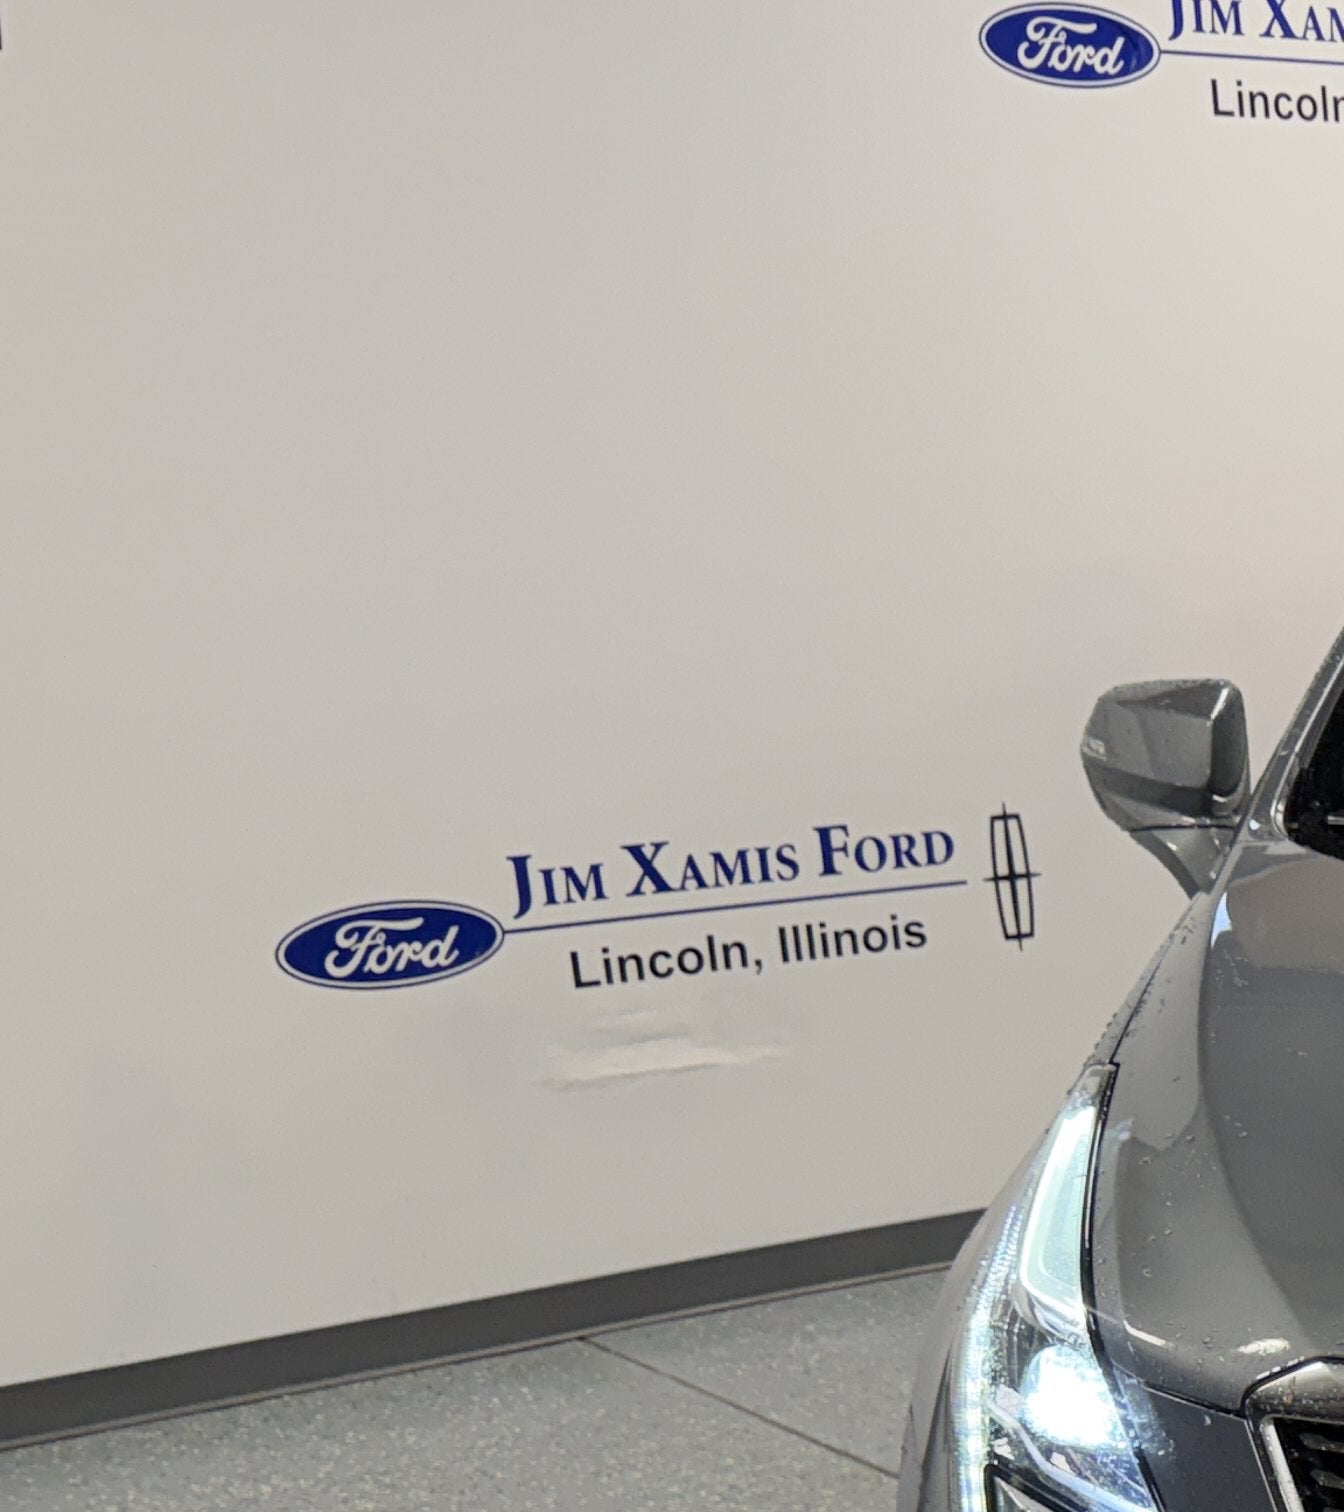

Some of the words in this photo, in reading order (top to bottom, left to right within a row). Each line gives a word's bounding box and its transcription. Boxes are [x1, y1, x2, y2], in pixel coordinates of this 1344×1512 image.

[1017, 15, 1125, 78] Ford
[1168, 0, 1245, 41] JIM
[505, 853, 606, 919] JIM
[620, 840, 801, 899] XAMIS
[812, 824, 955, 877] FORD
[324, 915, 460, 979] Ford
[568, 934, 763, 990] Lincoln,
[777, 913, 928, 964] Illinois
